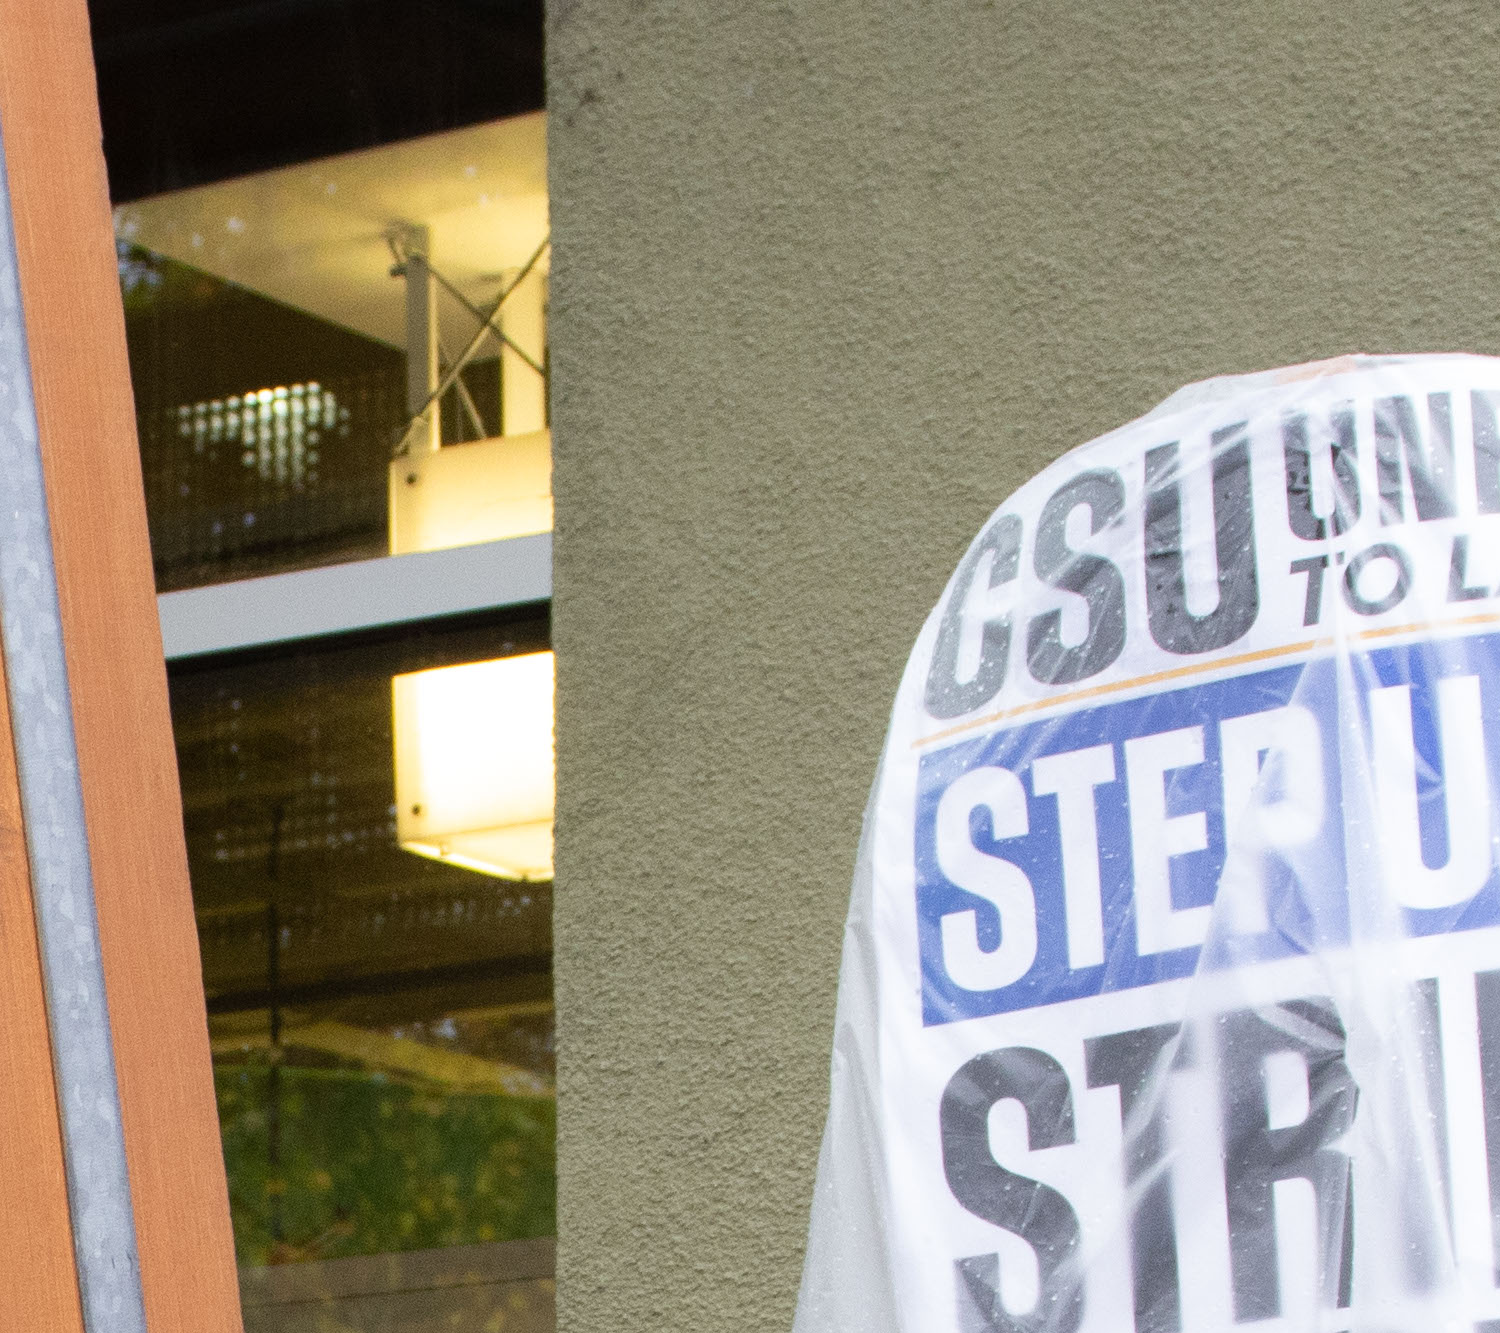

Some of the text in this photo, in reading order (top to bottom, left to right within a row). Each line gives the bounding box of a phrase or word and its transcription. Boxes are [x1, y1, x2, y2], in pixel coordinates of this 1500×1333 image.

[923, 421, 1259, 721] CSU
[1288, 541, 1413, 626] TO
[936, 706, 1324, 993] STEP
